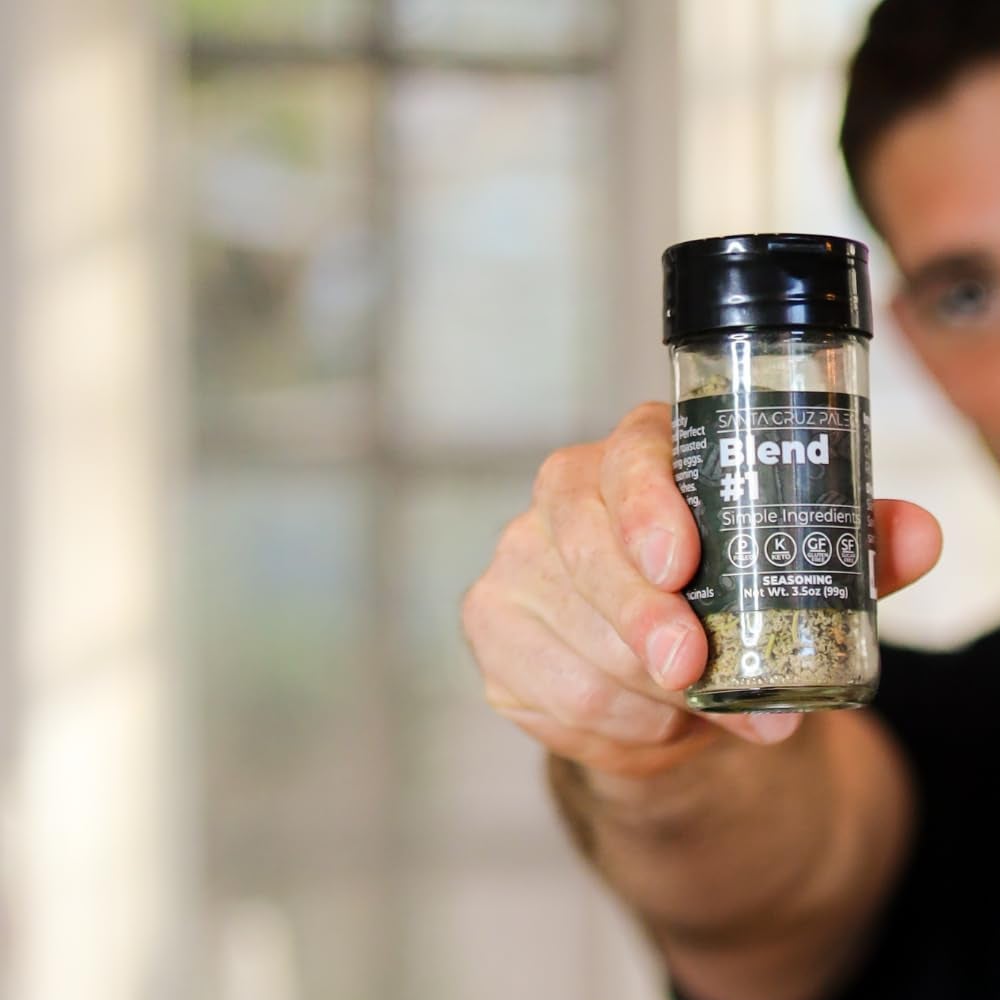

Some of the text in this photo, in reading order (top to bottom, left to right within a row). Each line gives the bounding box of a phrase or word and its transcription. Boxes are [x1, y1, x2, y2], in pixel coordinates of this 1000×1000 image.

[771, 411, 815, 425] CRUZ
[819, 411, 852, 427] PALE
[720, 433, 829, 467] Blend
[720, 472, 759, 502] #1
[722, 508, 778, 526] Simple
[775, 538, 786, 550] K
[807, 538, 826, 550] GF
[841, 539, 854, 551] SF
[770, 553, 791, 561] KETO
[763, 575, 832, 586] SEASONING
[767, 588, 789, 597] Wt.
[791, 587, 820, 597] 3.5oz
[823, 586, 848, 599] (99g)
